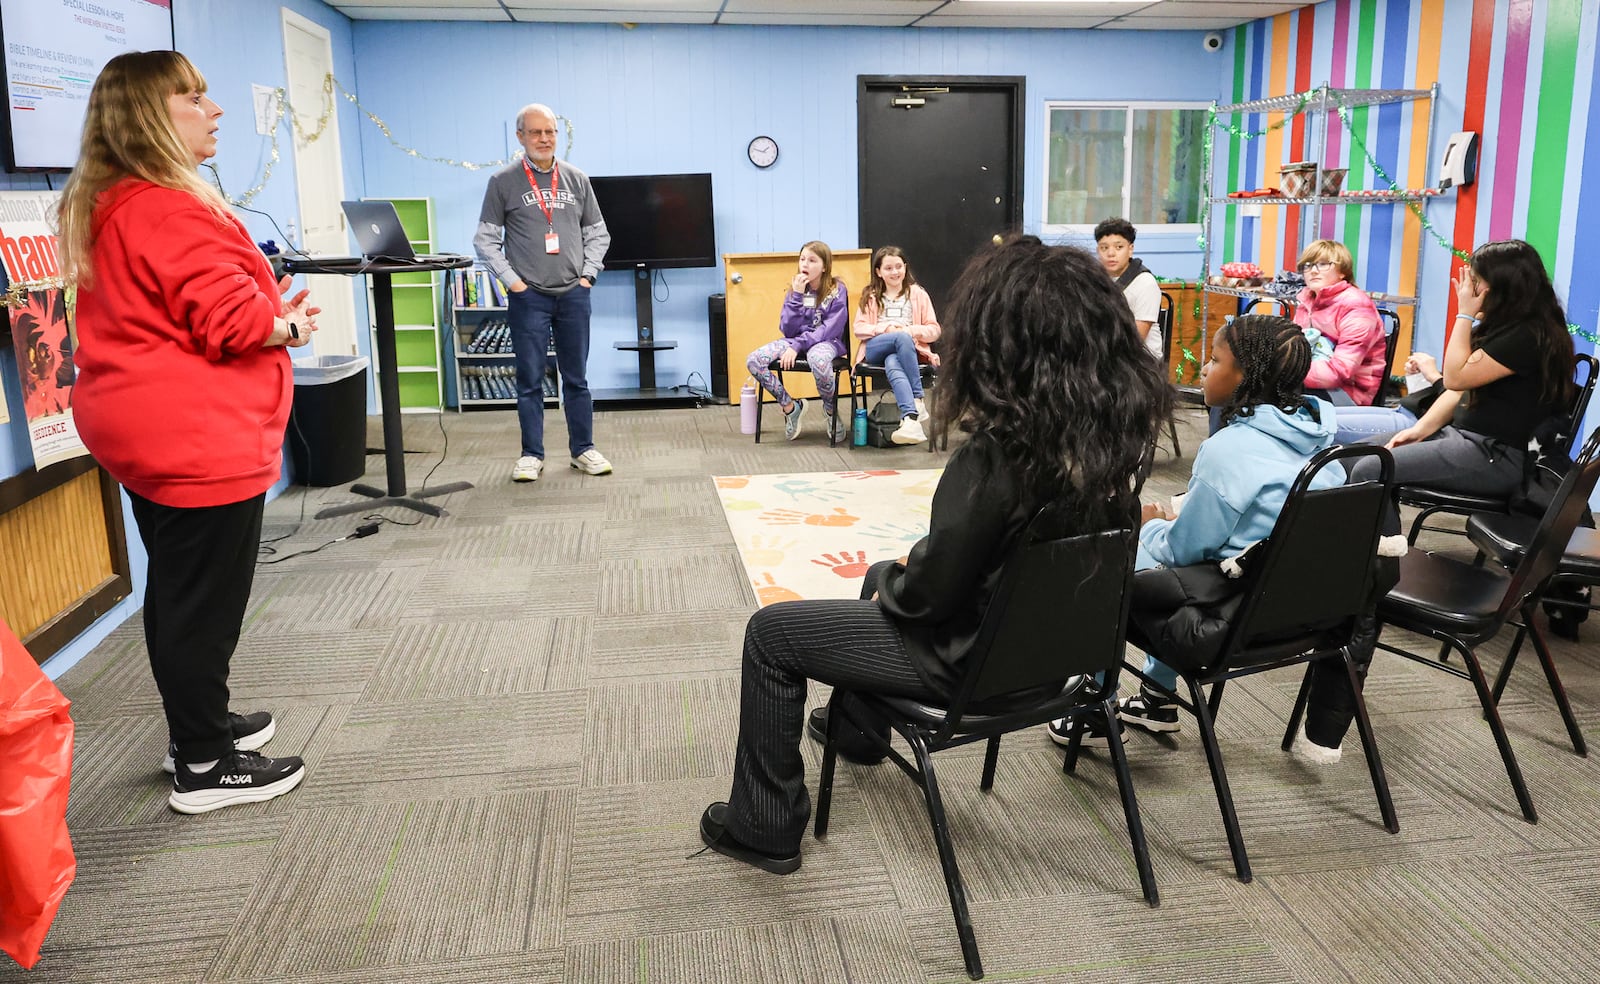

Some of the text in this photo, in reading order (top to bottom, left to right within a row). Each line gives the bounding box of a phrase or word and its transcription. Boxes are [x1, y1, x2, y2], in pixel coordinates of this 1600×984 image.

[63, 0, 86, 12] SPECIAL
[86, 4, 105, 17] LESSON
[9, 43, 26, 56] BIBLE
[26, 46, 52, 61] TIMELINE
[525, 191, 575, 203] LIEISE
[219, 774, 253, 785] HOKA
